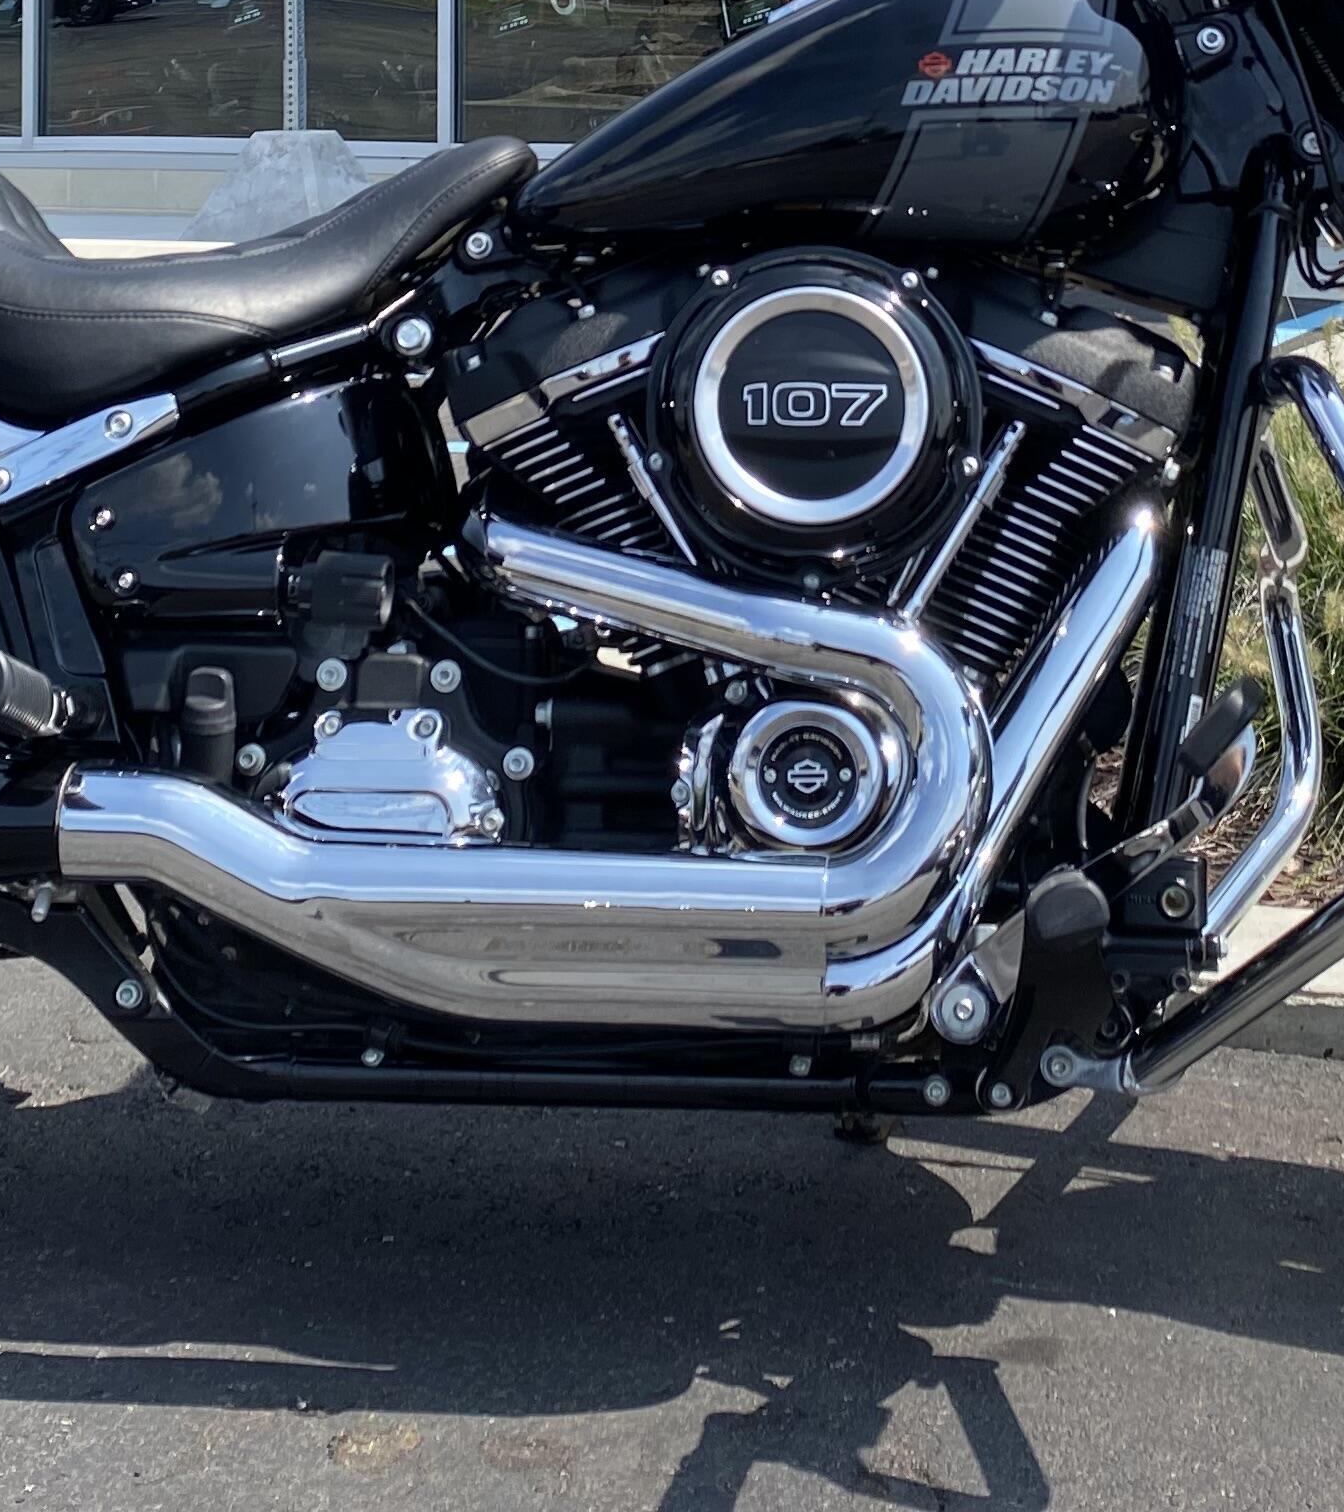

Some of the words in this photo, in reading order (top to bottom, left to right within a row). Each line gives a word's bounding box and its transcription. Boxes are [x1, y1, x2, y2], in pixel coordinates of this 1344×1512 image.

[956, 48, 1121, 76] HARLEY-
[900, 76, 1116, 106] DAVIDSON
[742, 382, 887, 426] 107
